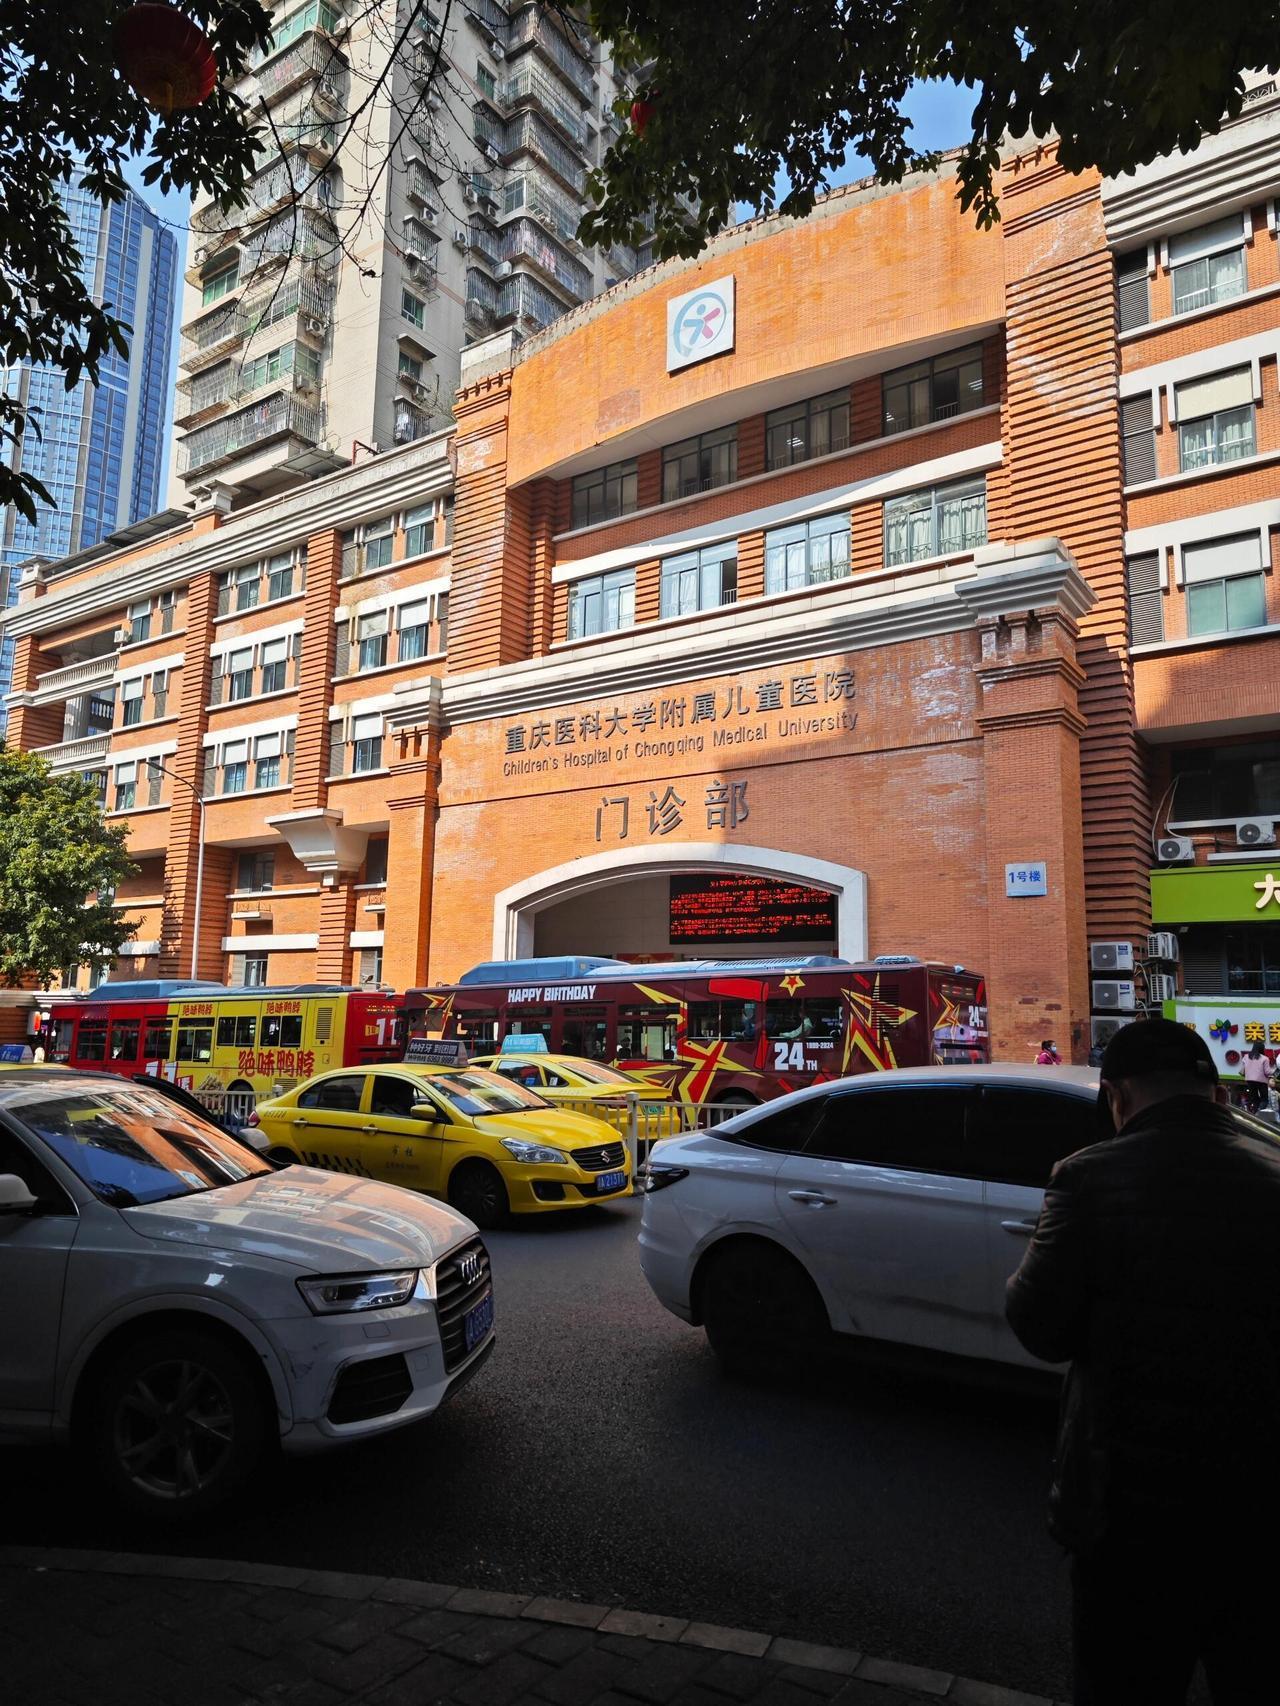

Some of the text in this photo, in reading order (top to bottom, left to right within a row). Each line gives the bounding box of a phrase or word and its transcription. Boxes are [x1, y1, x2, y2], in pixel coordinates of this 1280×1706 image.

[504, 668, 856, 754] 重庆医科大学附属儿童医院
[503, 711, 859, 777] Children's Hospital of Chongqing Medical University
[595, 779, 750, 842] 门诊部
[1008, 870, 1041, 883] 1号楼
[508, 985, 597, 1003] HAPPY BIRTHDAY
[237, 1050, 315, 1078] 绝味鸭脖
[774, 1042, 818, 1071] 24 TH
